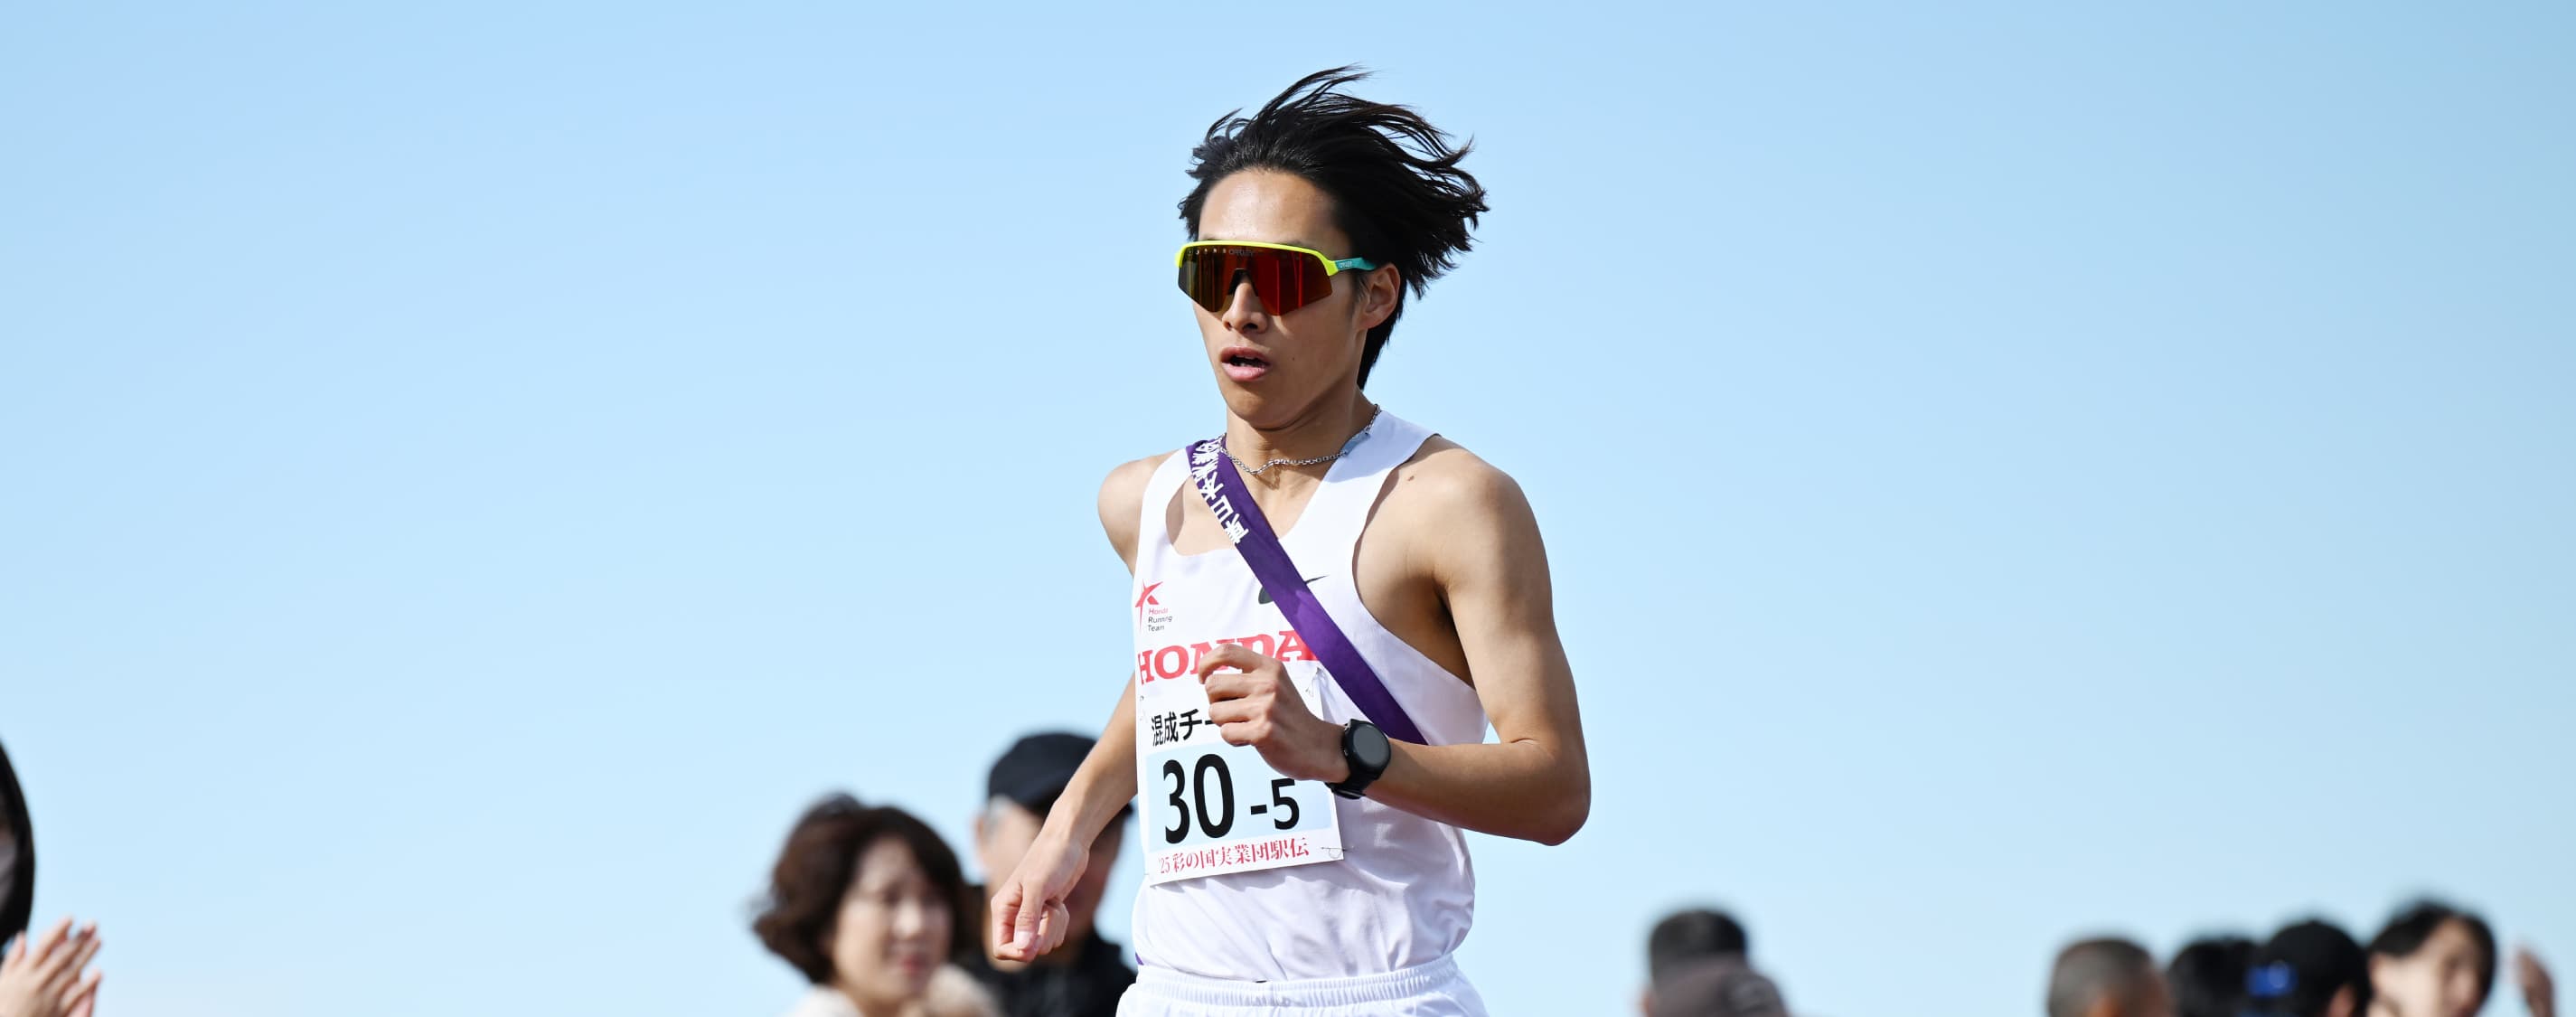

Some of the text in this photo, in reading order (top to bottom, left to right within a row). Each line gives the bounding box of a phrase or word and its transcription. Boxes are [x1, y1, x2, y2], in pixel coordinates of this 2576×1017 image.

[1147, 616, 1172, 624] Running
[1148, 624, 1165, 632] Team
[1162, 753, 1300, 844] 30 -5
